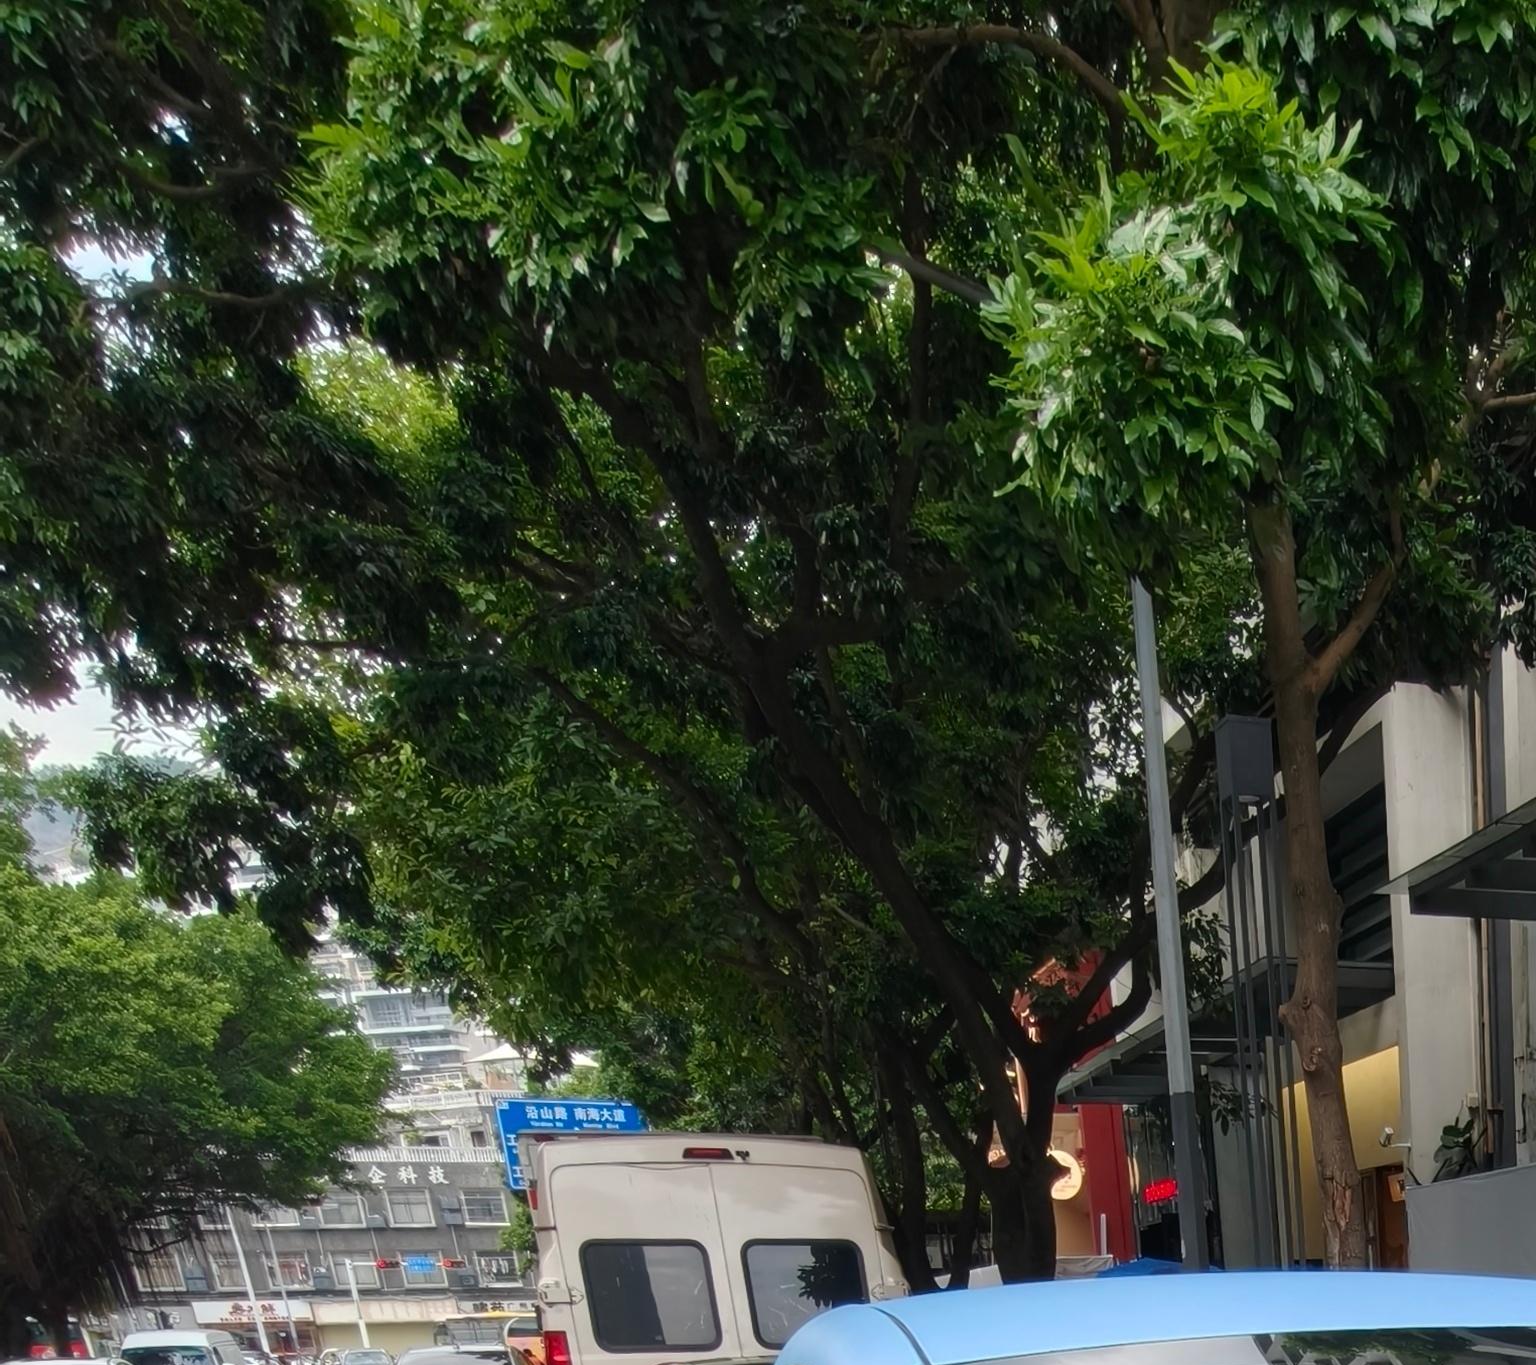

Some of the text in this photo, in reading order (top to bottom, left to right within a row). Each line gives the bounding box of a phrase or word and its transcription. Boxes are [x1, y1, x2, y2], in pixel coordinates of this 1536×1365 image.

[525, 1105, 627, 1122] 沿山路 南海大道
